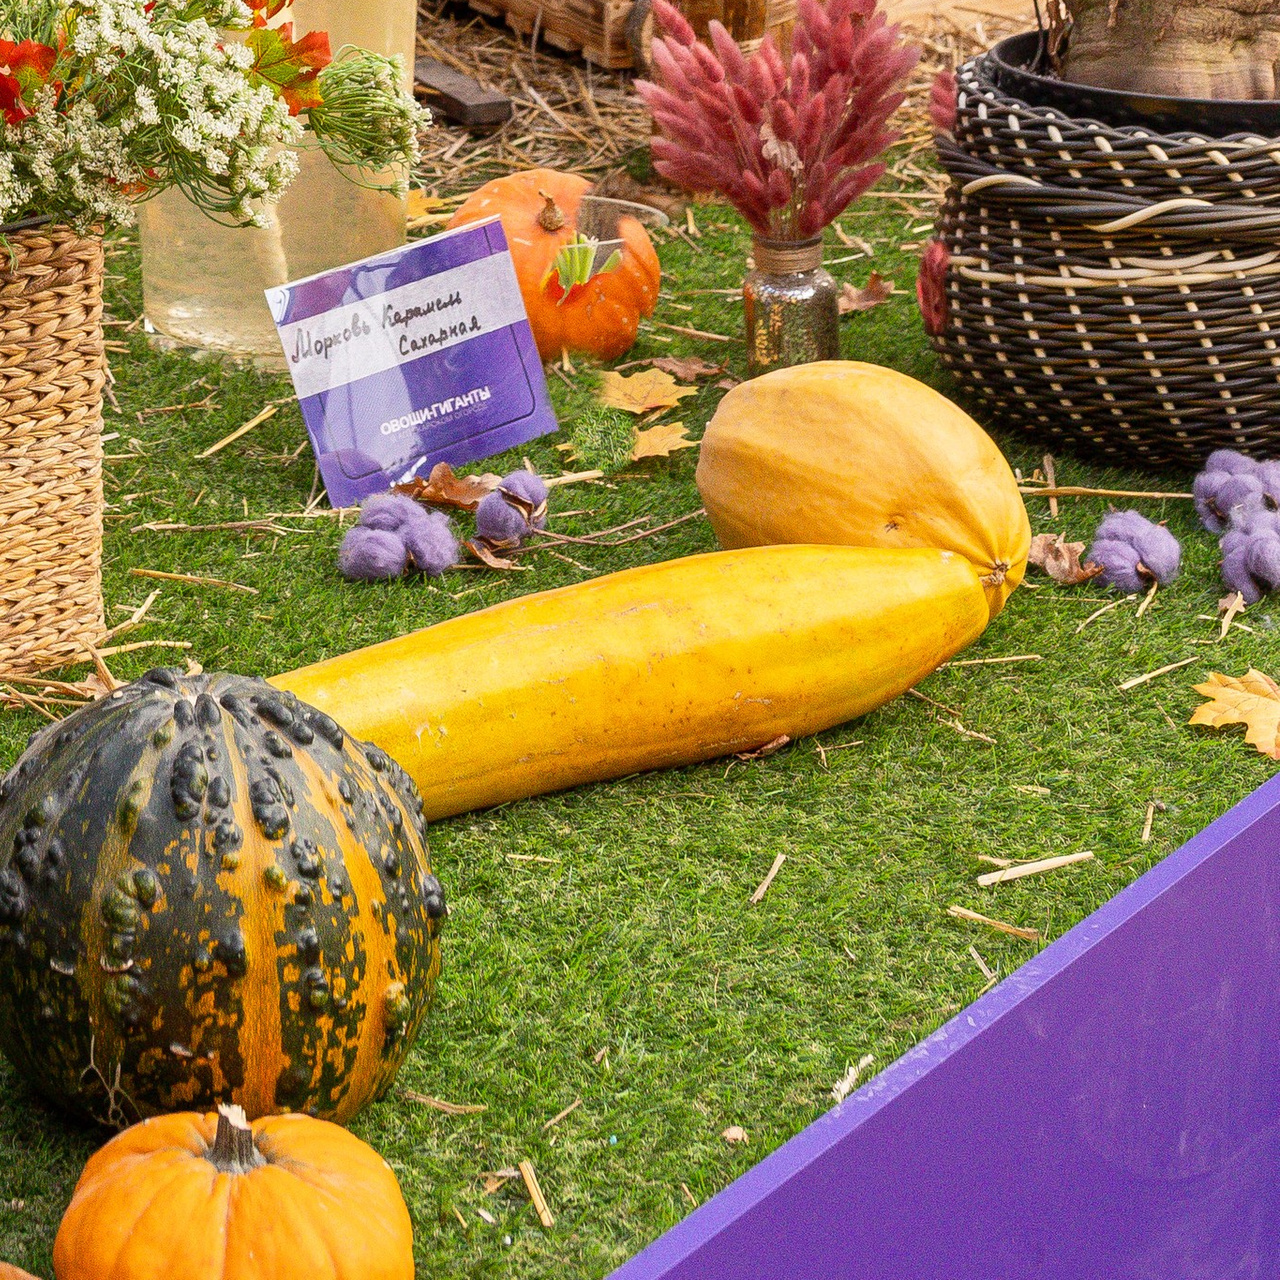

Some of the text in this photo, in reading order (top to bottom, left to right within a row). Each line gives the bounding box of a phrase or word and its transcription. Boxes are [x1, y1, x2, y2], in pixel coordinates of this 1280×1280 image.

[292, 291, 463, 362] Морковь Карамель
[399, 316, 481, 356] Сахарная
[380, 386, 491, 435] ОВОЩИ-ГИГАНТЫ
